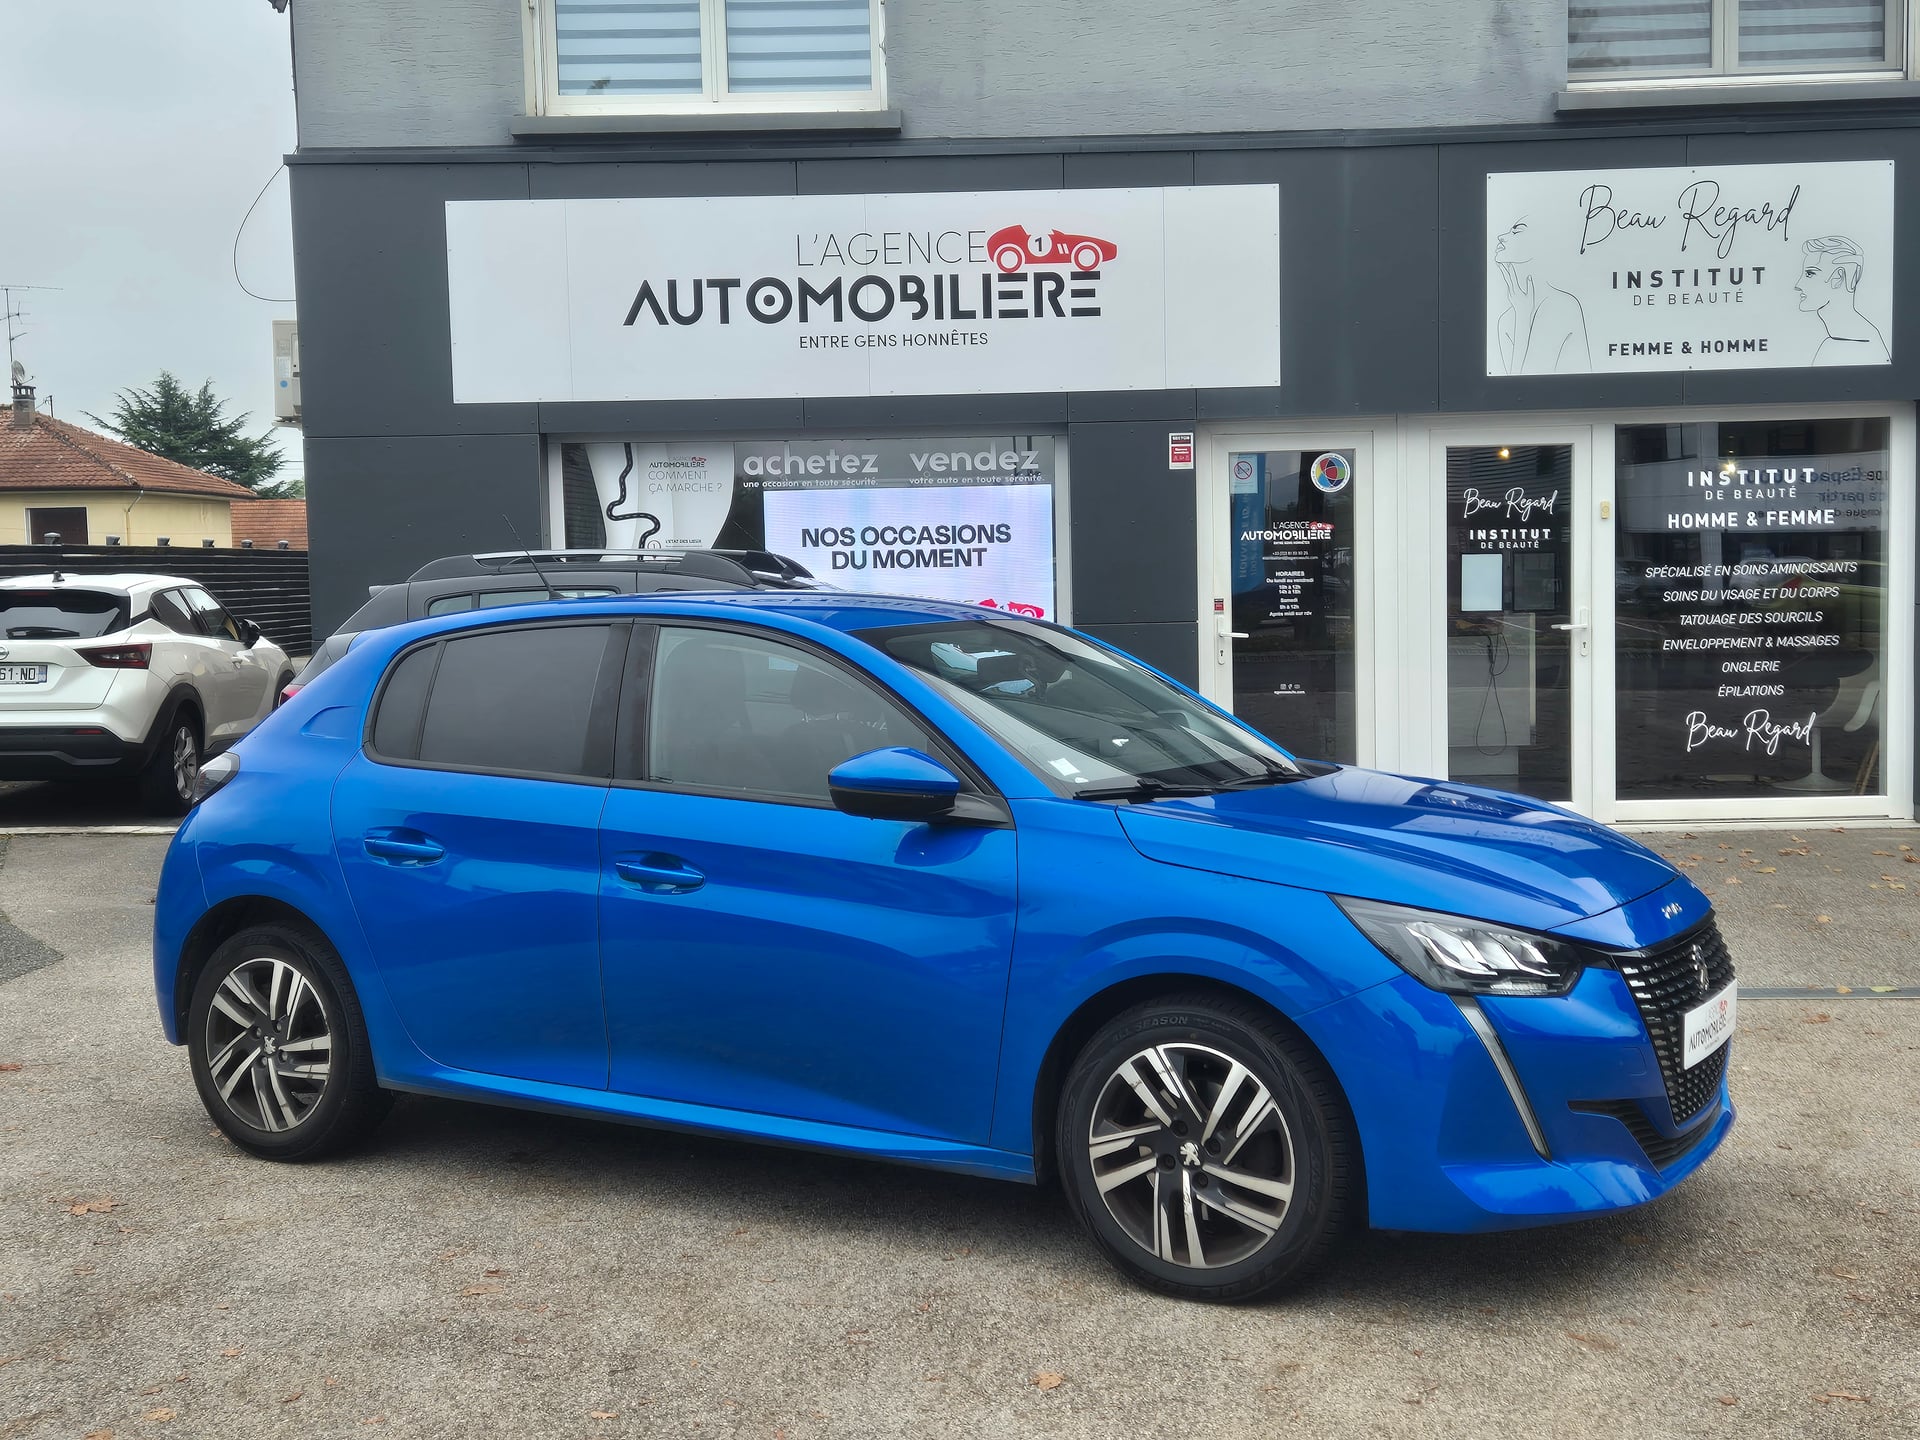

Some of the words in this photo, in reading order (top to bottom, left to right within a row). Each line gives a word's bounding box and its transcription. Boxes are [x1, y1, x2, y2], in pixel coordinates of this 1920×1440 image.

[1579, 184, 1666, 255] Beau
[1677, 180, 1800, 259] Regard
[797, 230, 987, 266] L'AGENCE
[1612, 266, 1766, 289] INSTITUT
[1633, 294, 1656, 306] DE
[1668, 288, 1744, 305] BEAUTÉ
[799, 335, 849, 349] ENTRE
[854, 334, 897, 348] GENS
[903, 329, 988, 347] HONNÊTES
[1608, 341, 1673, 357] FEMME
[1680, 340, 1693, 355] &
[1700, 338, 1769, 354] HOMME
[743, 442, 879, 476] achetez
[909, 442, 1039, 472] vendez
[648, 470, 708, 480] COMMENT
[937, 476, 959, 484] auto
[1688, 467, 1815, 487] INSTITUT
[648, 482, 664, 494] ÇA
[666, 482, 713, 493] MARCHE
[716, 482, 722, 492] ?
[762, 480, 799, 488] occasion
[1705, 489, 1724, 500] DE
[1734, 485, 1797, 499] BEAUTÉ
[1463, 488, 1501, 519] Beau
[1505, 487, 1559, 522] Regard
[1273, 521, 1310, 530] L'AGENCE
[1668, 511, 1738, 529] HOMME
[1746, 511, 1759, 527] &
[1766, 509, 1835, 526] FEMME
[801, 526, 855, 548] NOS
[860, 523, 1011, 547] OCCASIONS
[1469, 528, 1551, 540] INSTITUT
[1480, 541, 1494, 549] DE
[1499, 539, 1540, 549] BEAUTÉ
[831, 550, 867, 570] DU
[873, 547, 987, 570] MOMENT
[1645, 563, 1712, 578] SPÉCIALISÉ
[1714, 565, 1731, 576] EN
[1733, 563, 1769, 575] SOINS
[1770, 561, 1858, 574] AMINCISSANTS
[1662, 590, 1698, 602] SOINS
[1700, 589, 1718, 600] DU
[1719, 588, 1760, 600] VISAGE
[1763, 588, 1779, 599] ET
[1779, 587, 1799, 599] DU
[1799, 586, 1840, 598] CORPS
[1680, 613, 1738, 626] TATOUAGE
[1739, 612, 1762, 624] DES
[1764, 611, 1823, 624] SOURCILS
[1662, 637, 1764, 650] ENVELOPPEMENT
[1765, 636, 1774, 648] &
[1776, 635, 1840, 647] MASSAGES
[1721, 660, 1781, 673] ONGLERIE
[1718, 683, 1784, 697] ÉPILATIONS
[1685, 711, 1738, 752] Beau
[1743, 709, 1817, 756] Regard
[1134, 1016, 1188, 1032] SEASON
